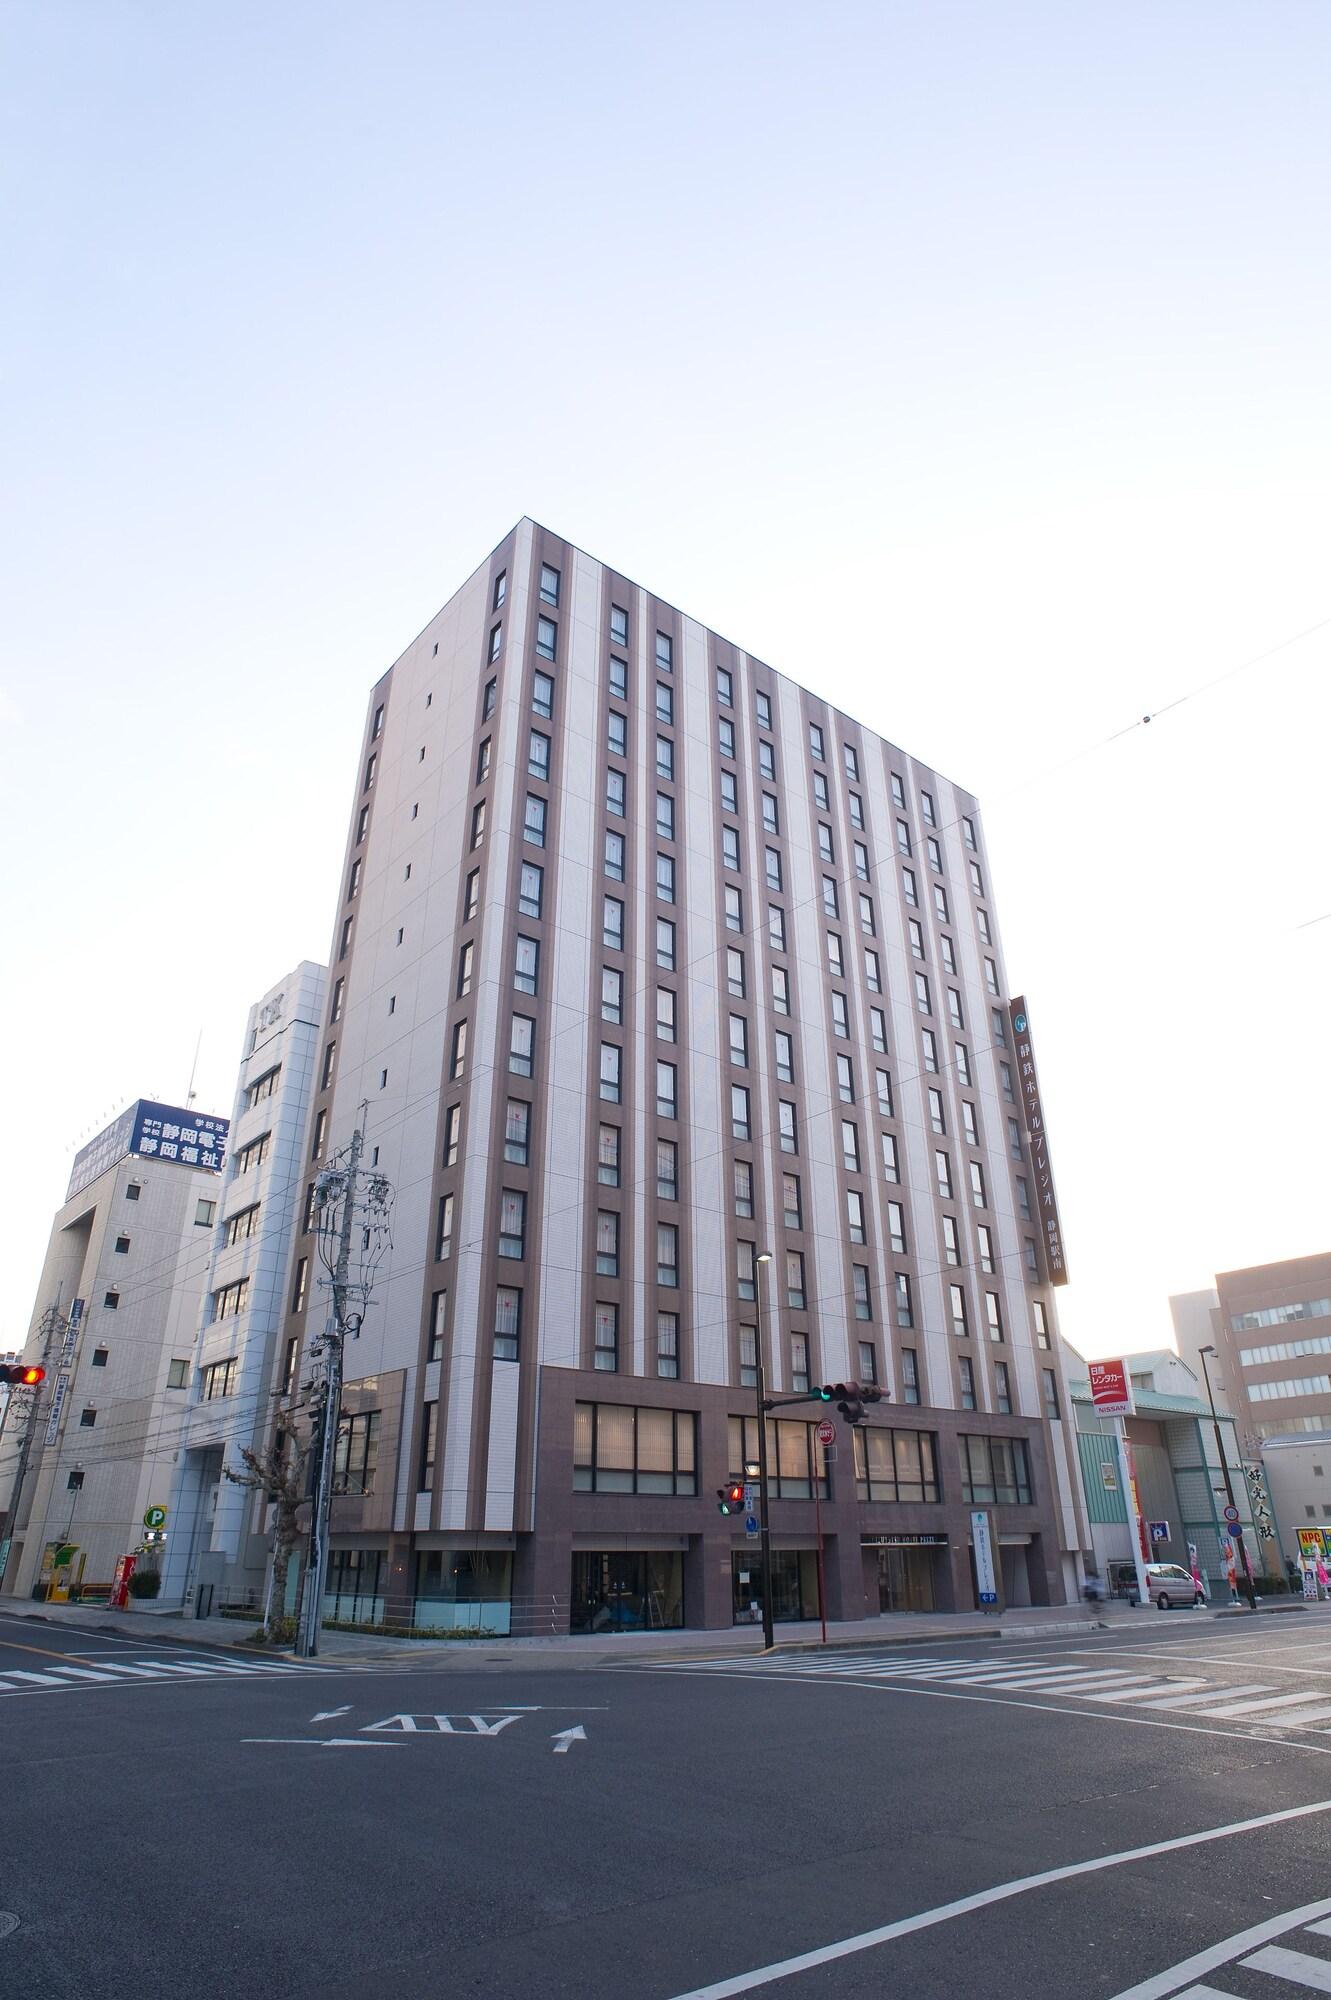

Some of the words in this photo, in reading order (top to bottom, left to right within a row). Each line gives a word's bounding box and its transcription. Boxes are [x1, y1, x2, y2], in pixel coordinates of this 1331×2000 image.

[139, 1136, 226, 1168] 静岡福祉
[1092, 1374, 1122, 1385] レンタカー
[1098, 1404, 1126, 1413] NISSAN
[151, 1510, 163, 1525] P
[1301, 1532, 1321, 1543] NPC
